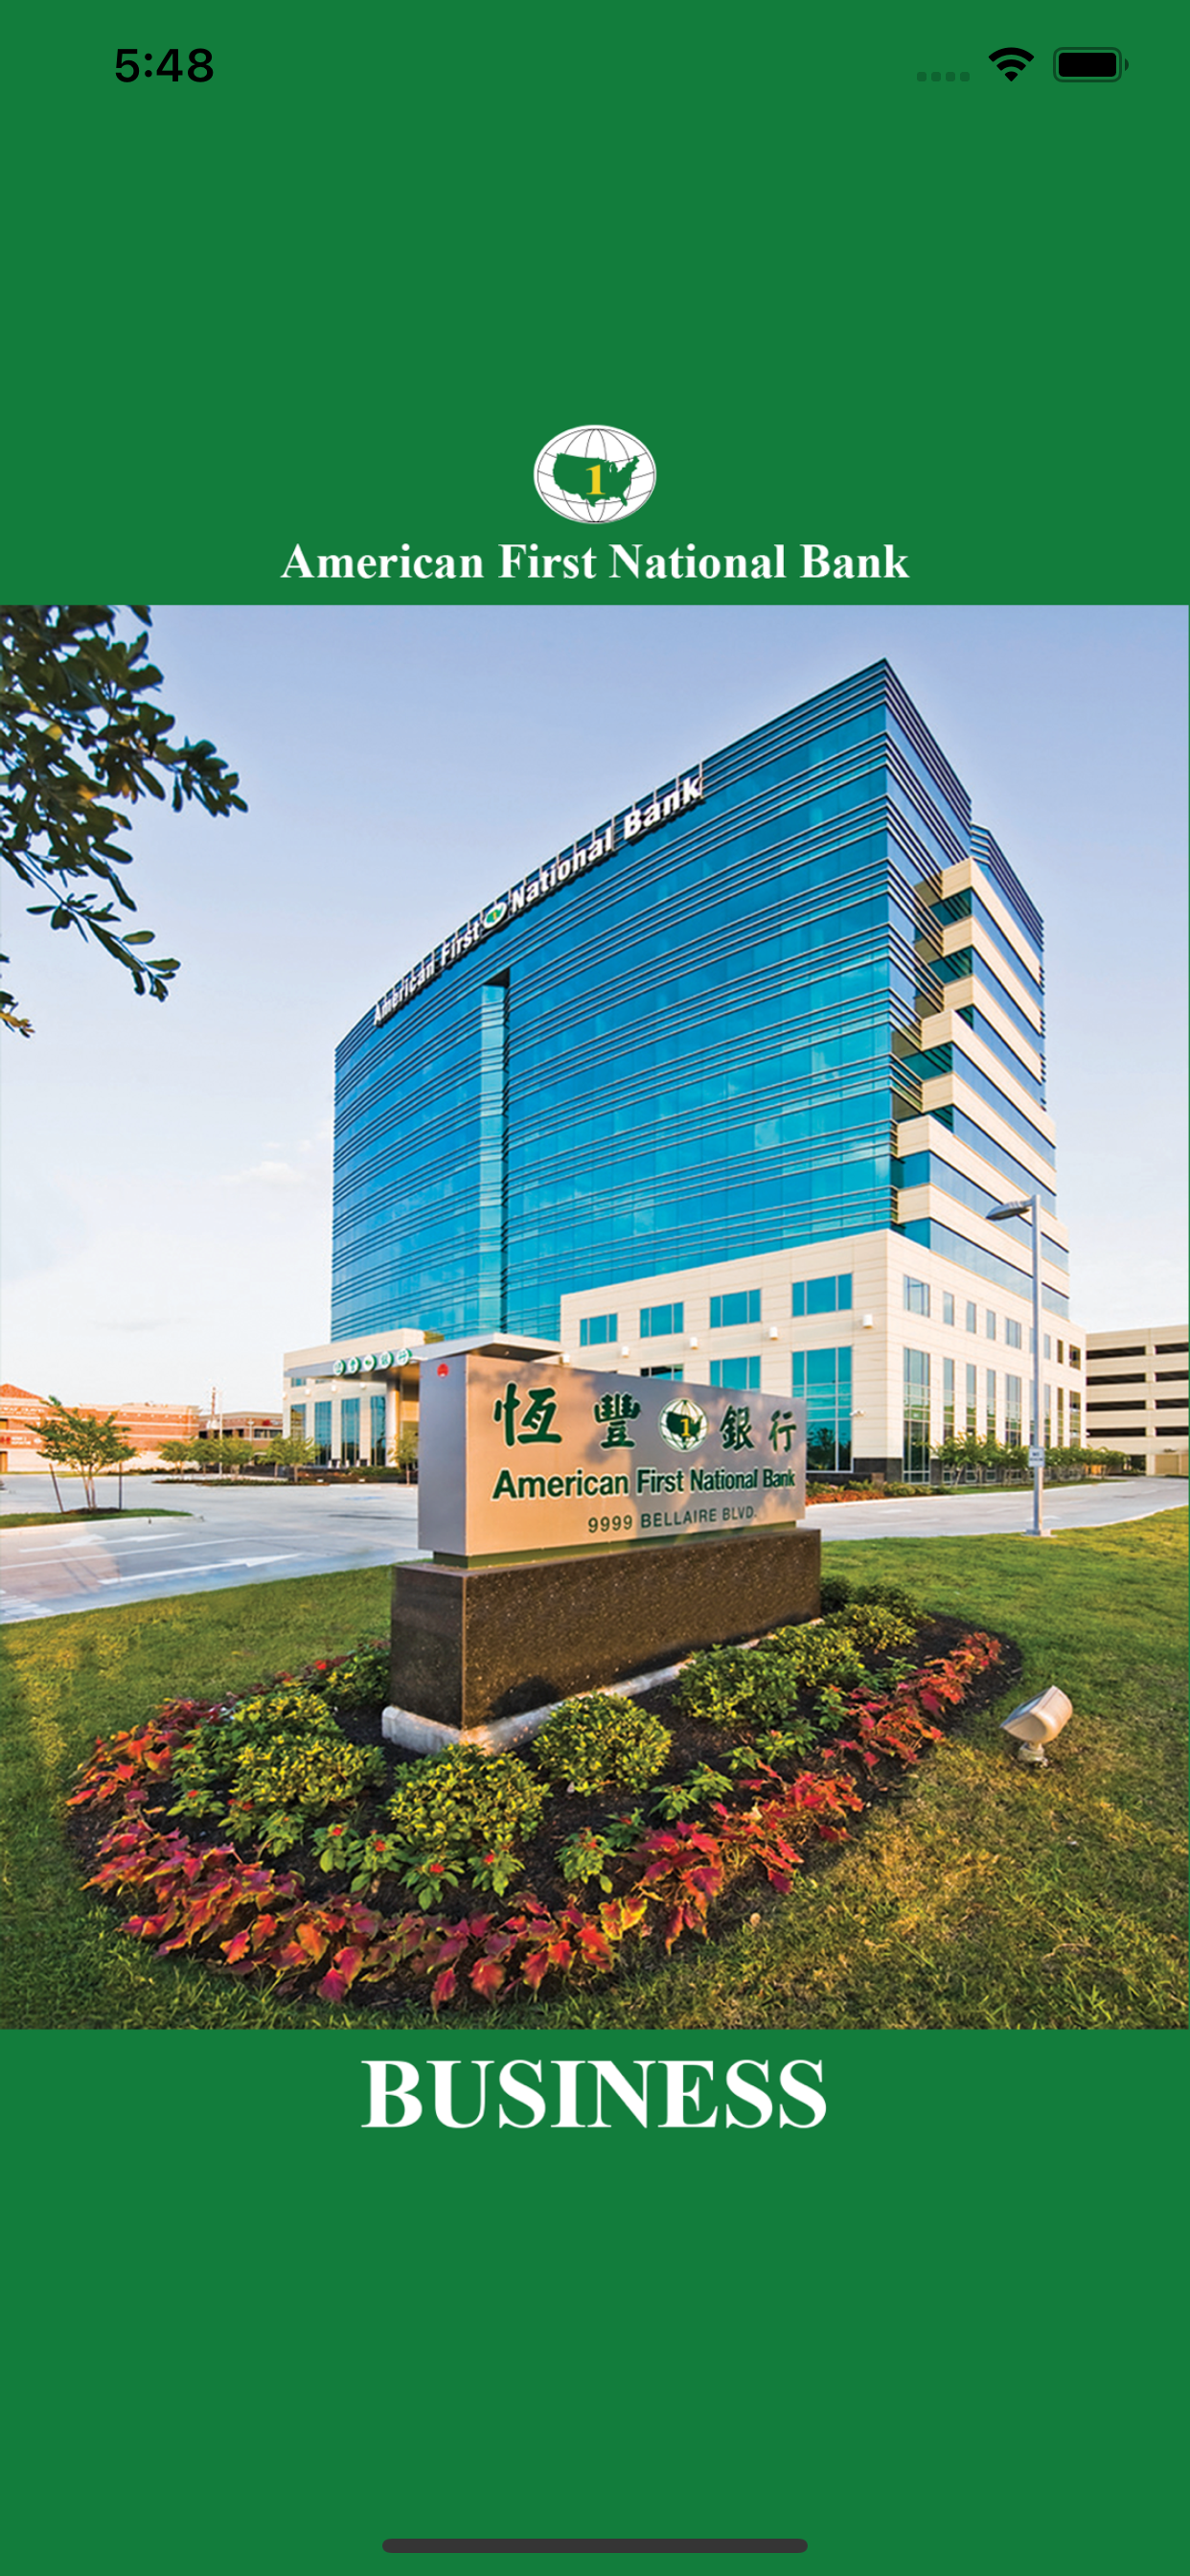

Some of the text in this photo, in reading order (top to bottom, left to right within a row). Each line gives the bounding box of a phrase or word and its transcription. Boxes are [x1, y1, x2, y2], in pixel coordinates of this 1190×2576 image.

[374, 775, 703, 1024] American First National Bank
[679, 1416, 691, 1438] 1
[491, 1468, 796, 1500] American First National Bank
[587, 1506, 758, 1533] 9999 BELLAIRE BLVD.
